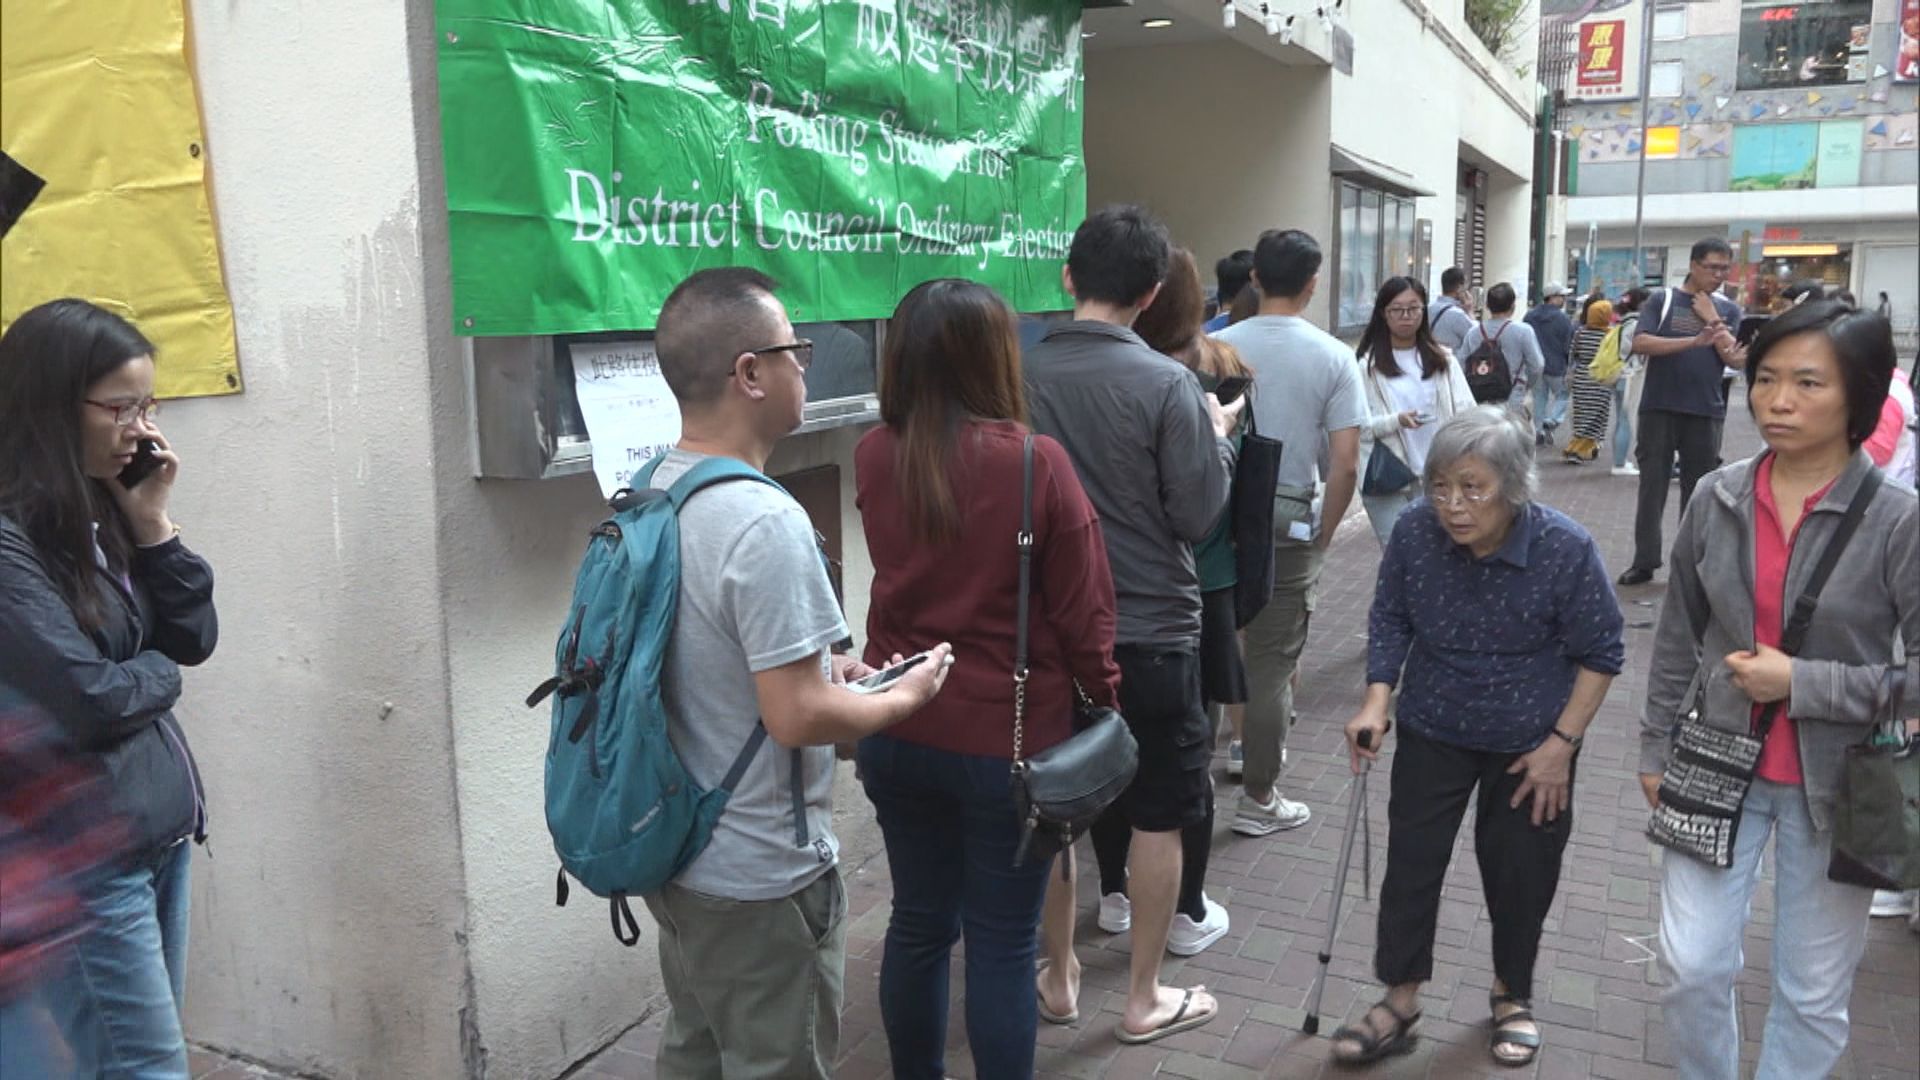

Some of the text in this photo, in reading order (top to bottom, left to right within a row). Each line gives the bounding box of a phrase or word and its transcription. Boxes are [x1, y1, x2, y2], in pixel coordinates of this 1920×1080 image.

[747, 80, 1010, 181] Polling Station for
[563, 167, 742, 250] District
[754, 188, 885, 255] Council
[896, 201, 994, 271] Ordinary
[626, 446, 652, 462] THIS
